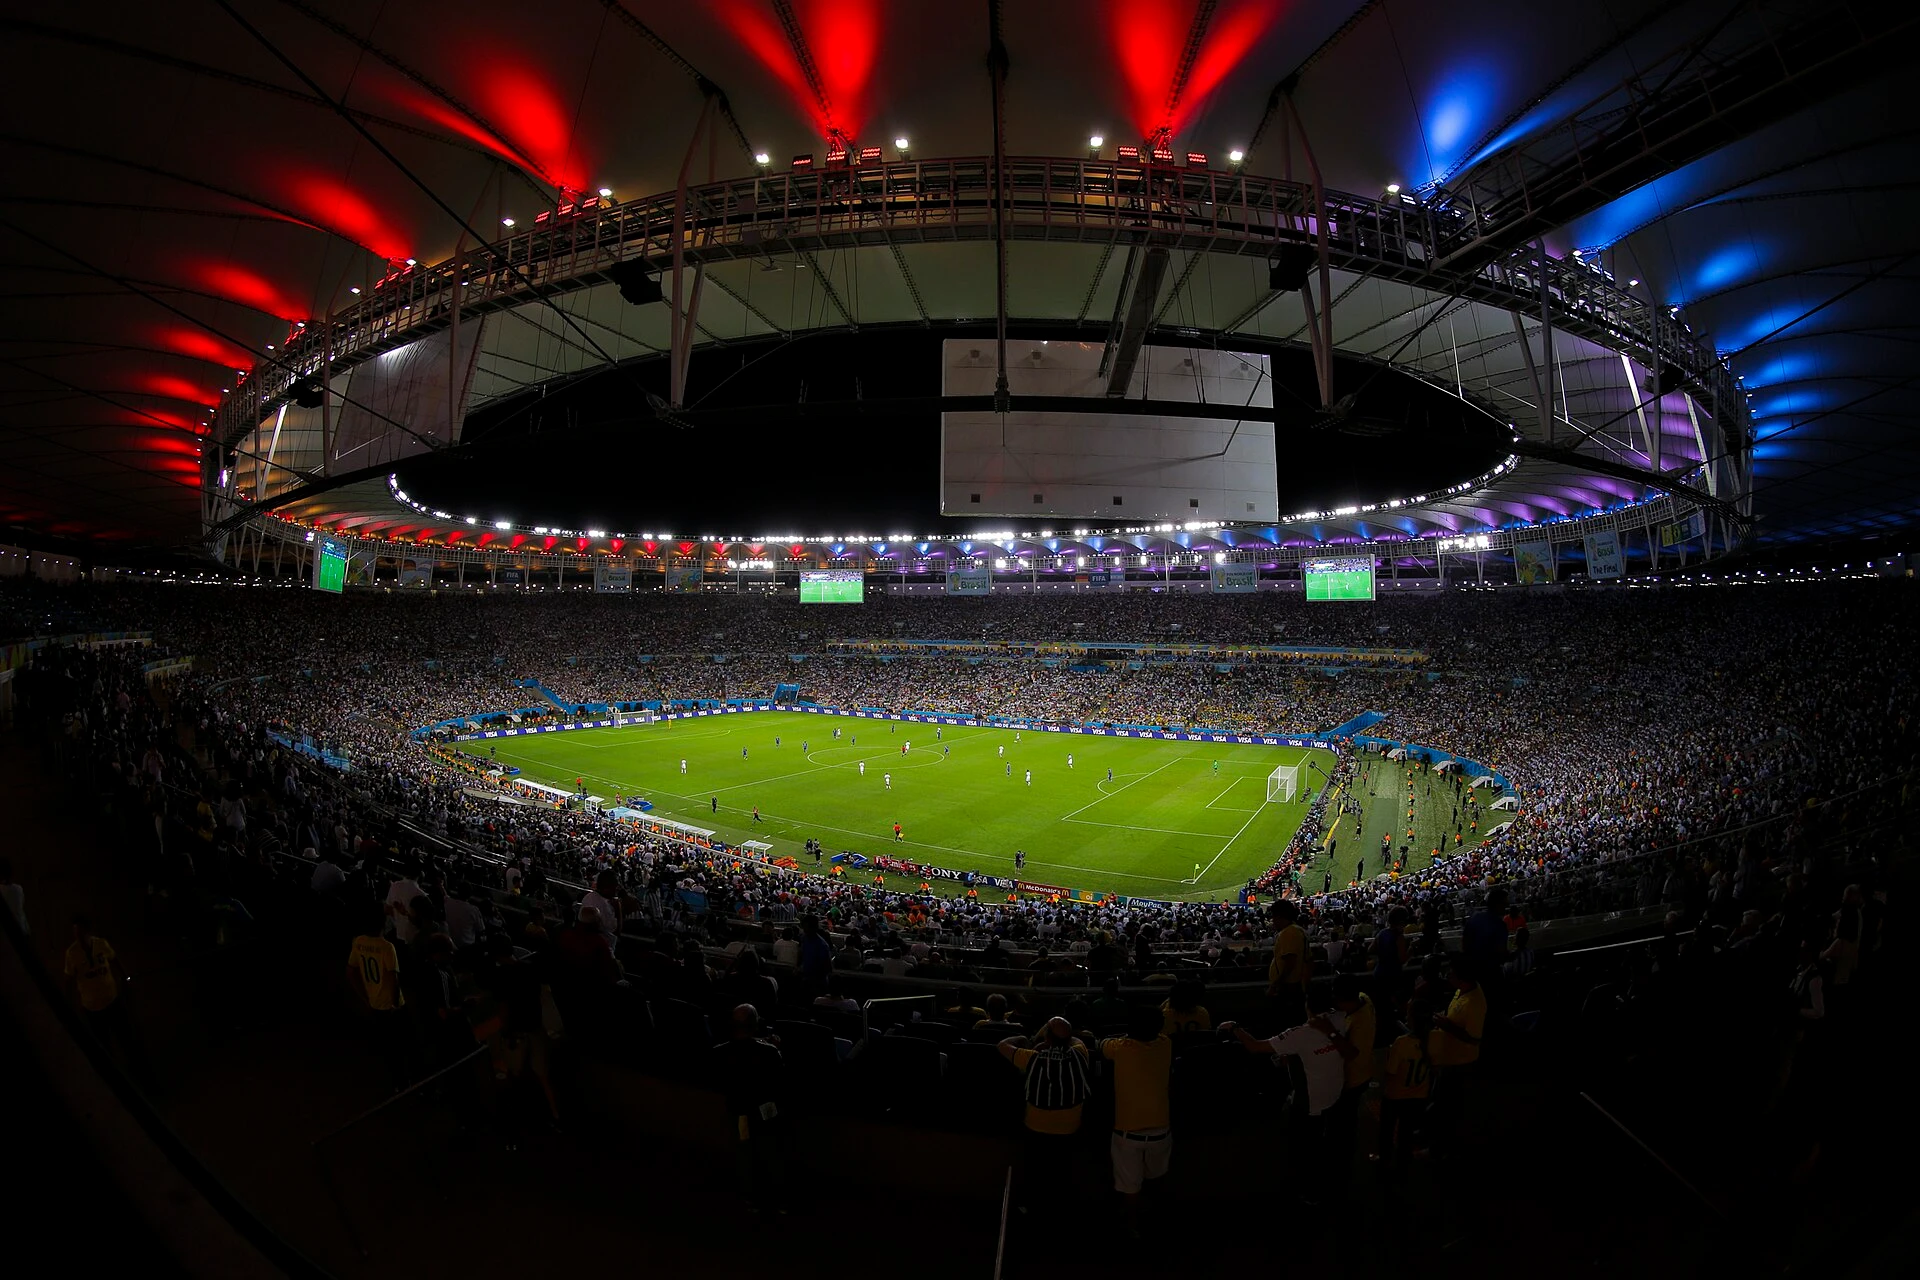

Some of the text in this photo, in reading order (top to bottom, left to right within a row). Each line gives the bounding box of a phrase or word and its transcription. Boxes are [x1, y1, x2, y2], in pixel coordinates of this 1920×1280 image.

[1593, 564, 1618, 574] The Final
[960, 581, 986, 589] Brasil
[1226, 576, 1253, 586] Brasil
[1237, 736, 1252, 744] VISA
[1025, 884, 1062, 895] McDonald's
[361, 955, 380, 984] 10
[1405, 1060, 1428, 1088] 10
